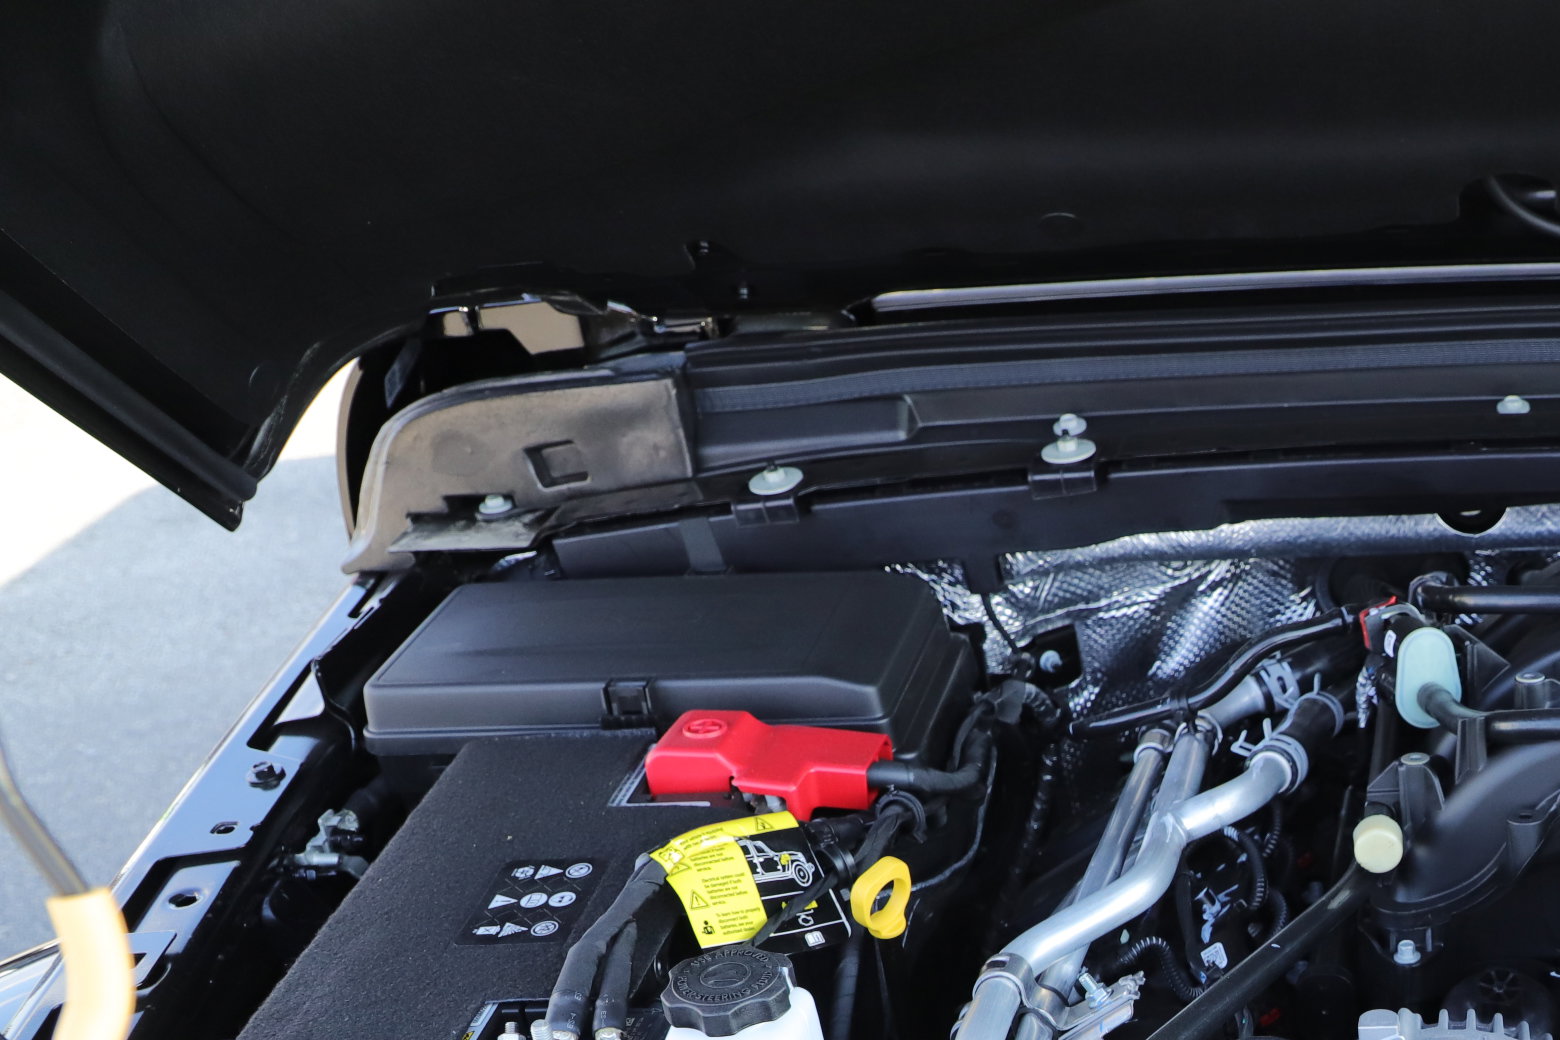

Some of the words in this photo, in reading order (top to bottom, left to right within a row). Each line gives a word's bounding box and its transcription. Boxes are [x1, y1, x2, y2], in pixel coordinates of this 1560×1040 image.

[690, 954, 712, 968] USE
[714, 948, 770, 964] APPROVED
[677, 975, 697, 998] POWER
[695, 987, 751, 1002] STEERING
